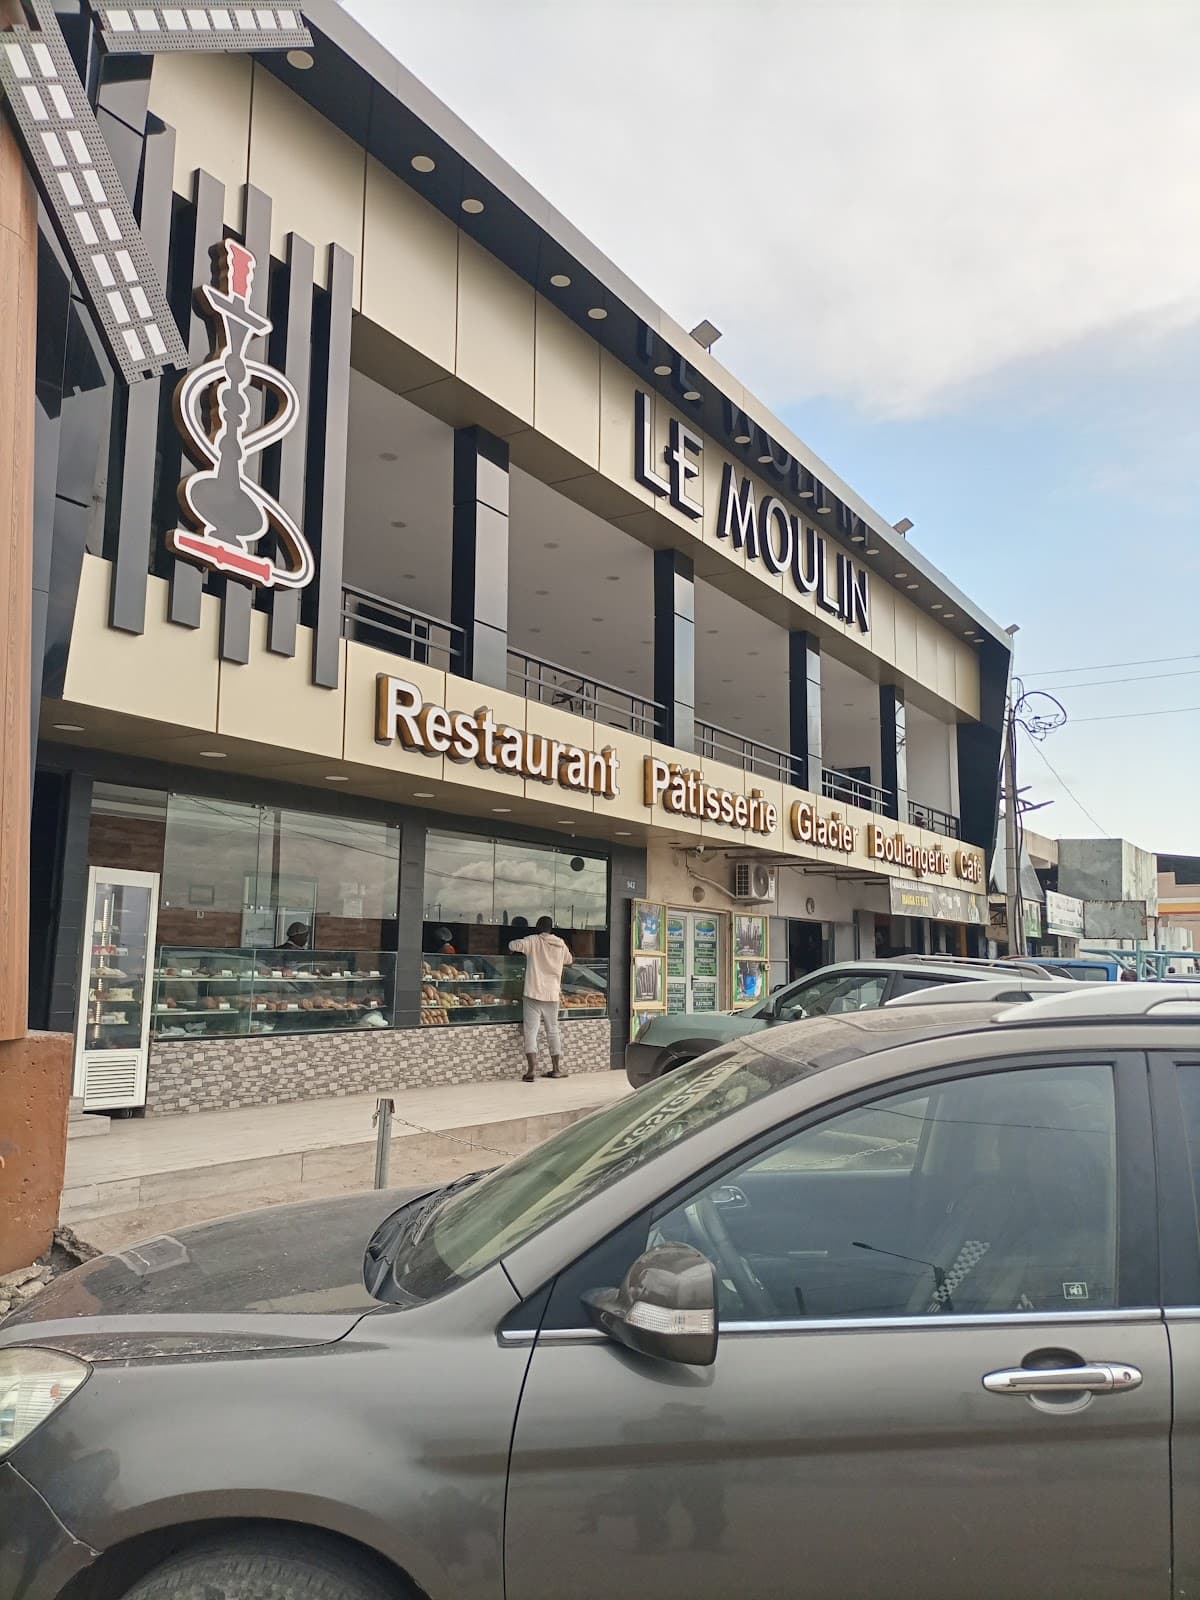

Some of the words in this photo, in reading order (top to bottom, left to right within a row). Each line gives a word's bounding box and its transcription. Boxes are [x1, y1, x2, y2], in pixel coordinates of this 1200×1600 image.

[636, 390, 703, 520] LE
[717, 462, 869, 633] MOULIN
[376, 673, 620, 799] Restaurant
[644, 756, 777, 834] Pâtisserie
[791, 800, 858, 853] Glacier
[868, 824, 950, 877] Boulangerie
